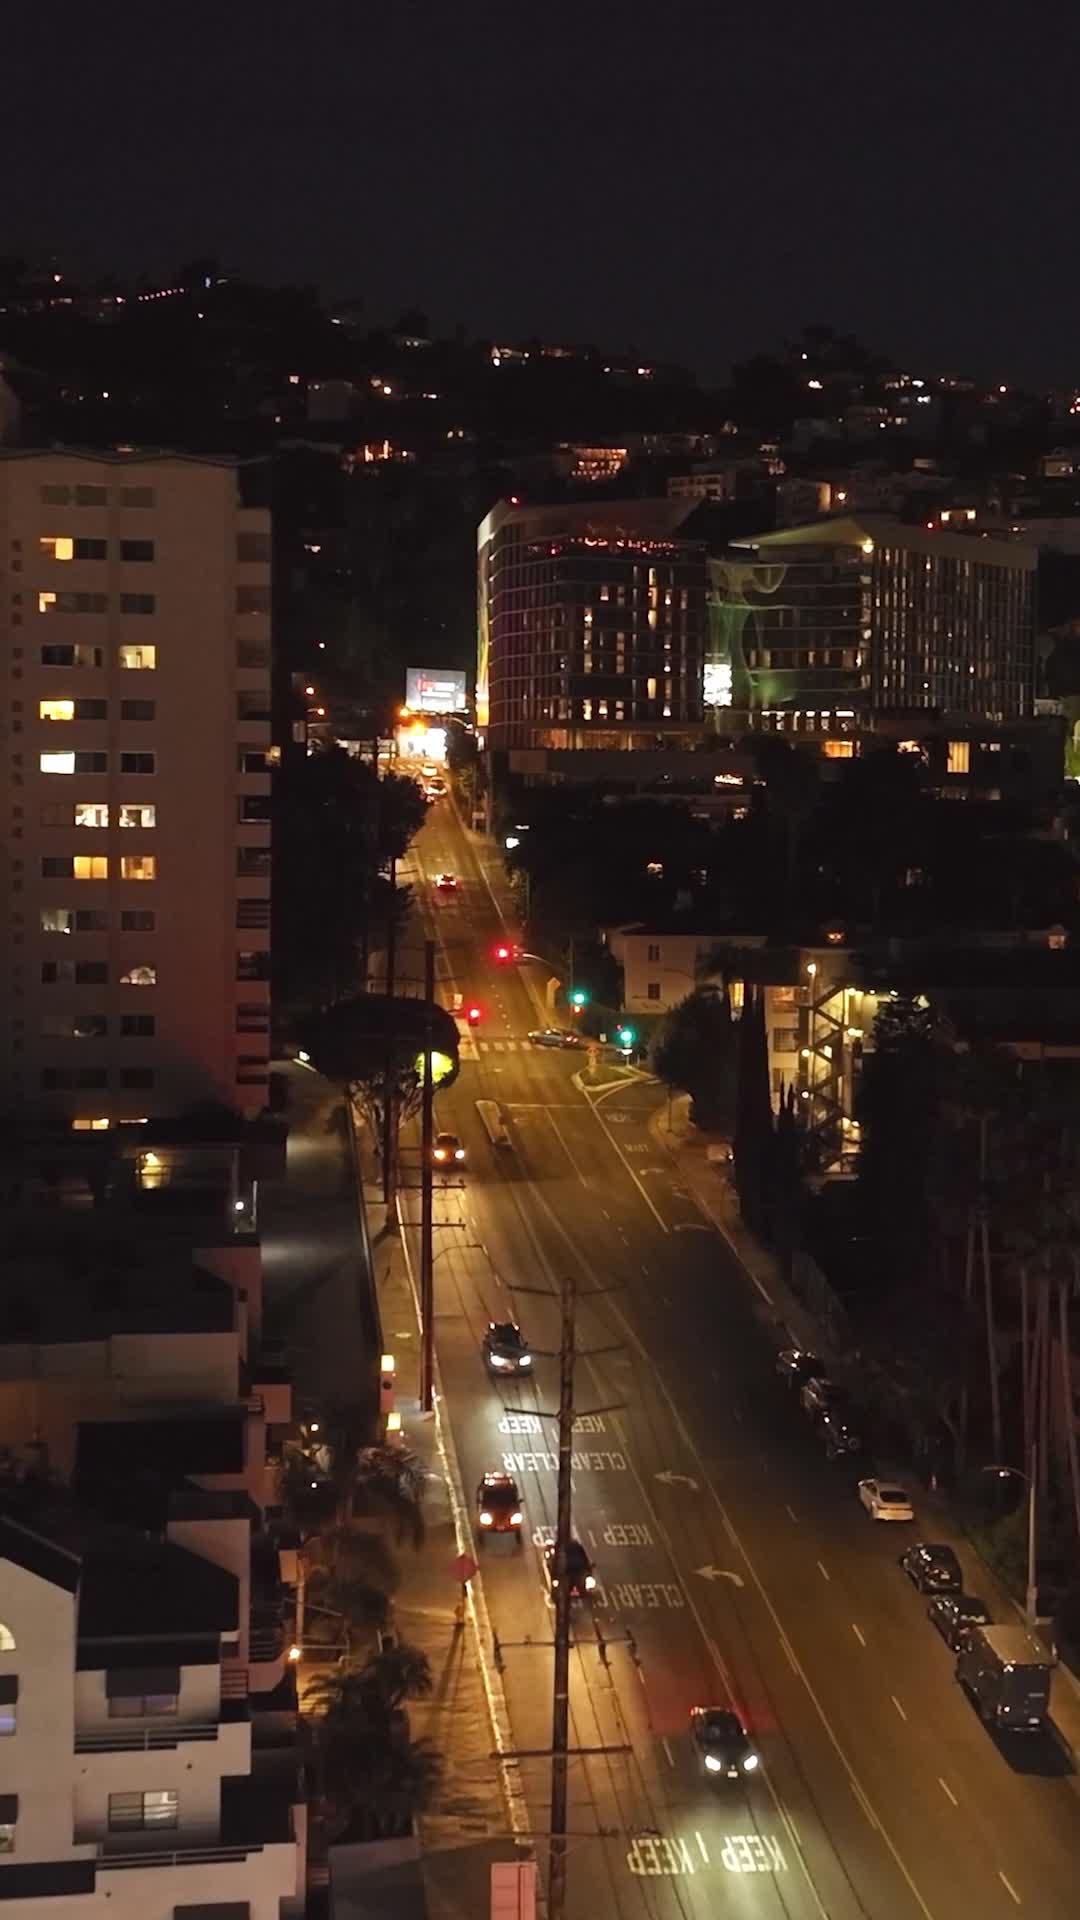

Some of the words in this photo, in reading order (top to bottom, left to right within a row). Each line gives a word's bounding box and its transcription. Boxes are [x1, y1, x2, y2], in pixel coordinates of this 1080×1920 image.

[498, 1416, 543, 1433] KEEP
[571, 1416, 606, 1432] KEE
[604, 1525, 654, 1545] KEEP
[619, 1584, 685, 1608] CLEAR
[626, 1837, 695, 1875] KEEP
[720, 1835, 789, 1872] KEEP
